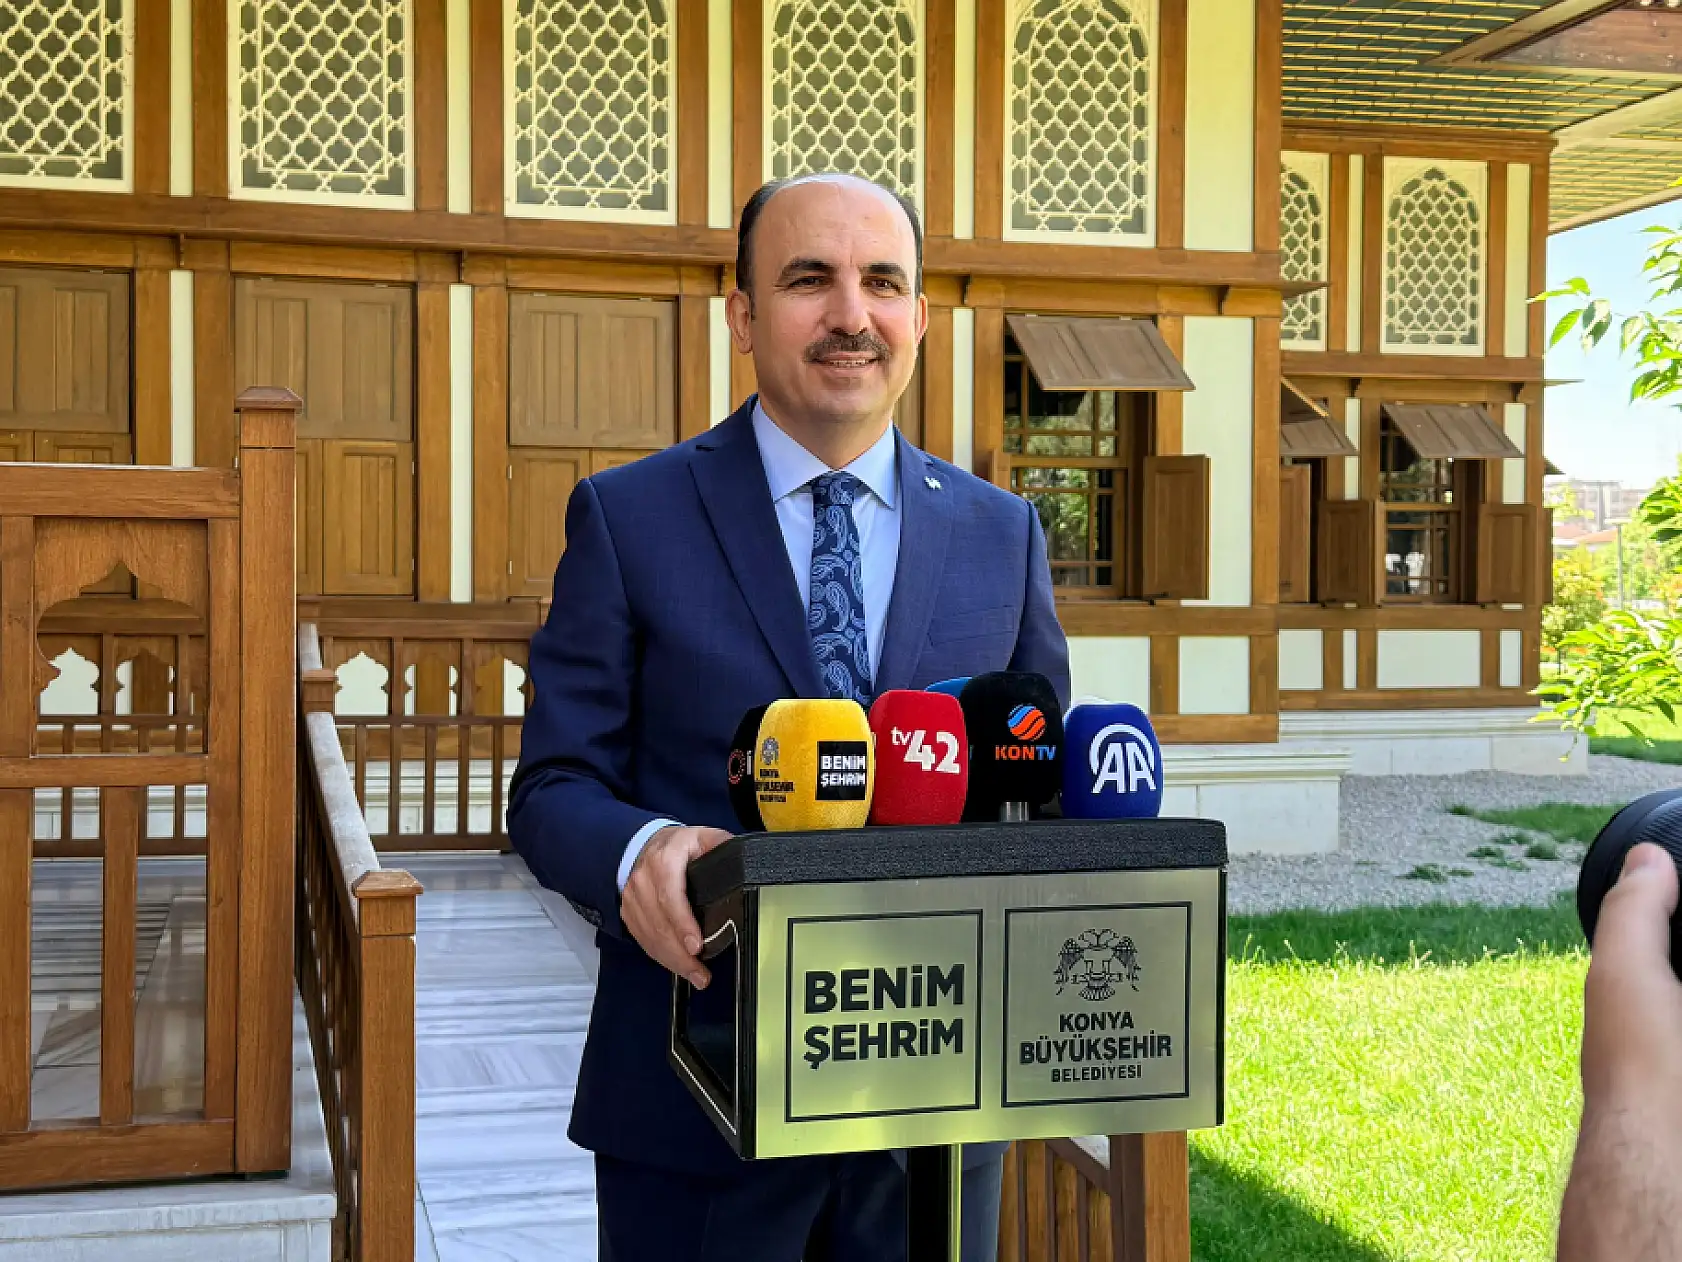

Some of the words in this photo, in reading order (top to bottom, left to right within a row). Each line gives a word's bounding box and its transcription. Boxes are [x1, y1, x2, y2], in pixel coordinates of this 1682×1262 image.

[1059, 1011, 1134, 1032] KONYA
[1020, 1030, 1172, 1065] BÜYÜKŞEHİR
[1051, 1061, 1142, 1083] BELEDİYESİ
